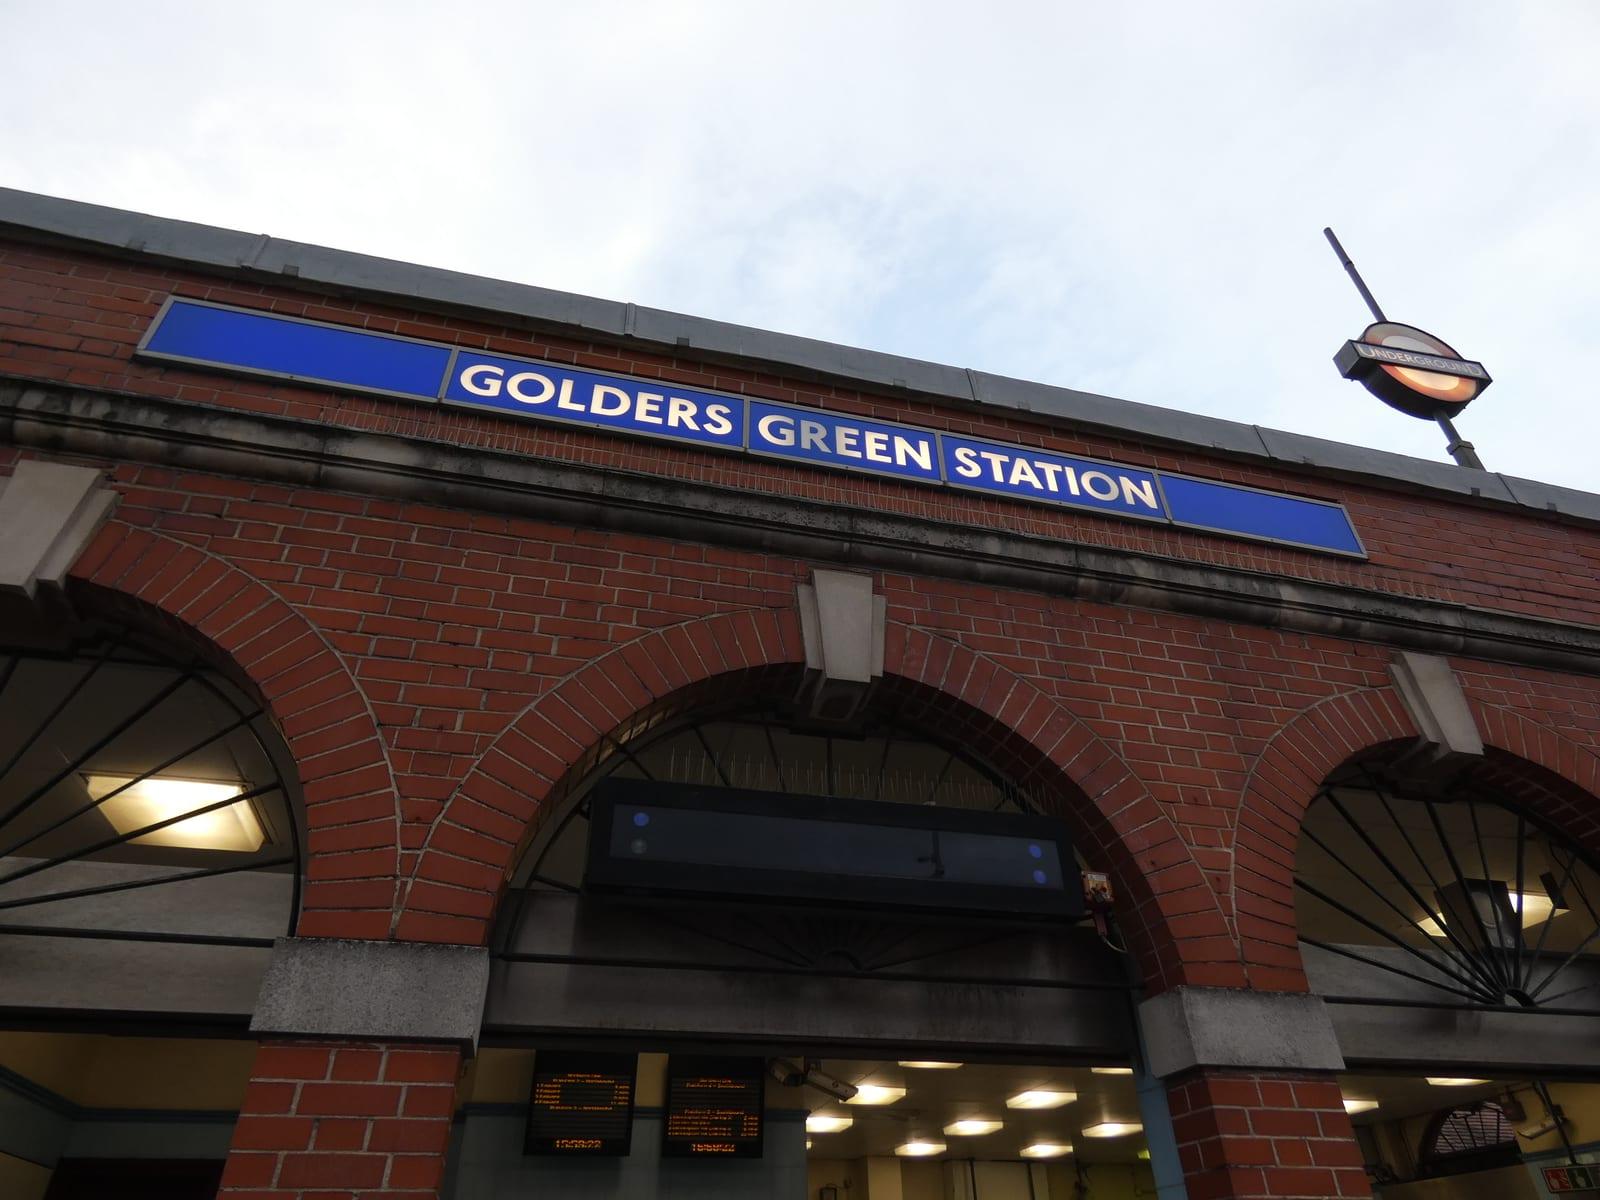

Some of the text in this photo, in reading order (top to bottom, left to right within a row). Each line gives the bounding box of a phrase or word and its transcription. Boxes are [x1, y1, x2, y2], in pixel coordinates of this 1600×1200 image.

[1356, 344, 1482, 376] UNDERGROUND
[459, 364, 1159, 510] GOLDERS GREEN STATION
